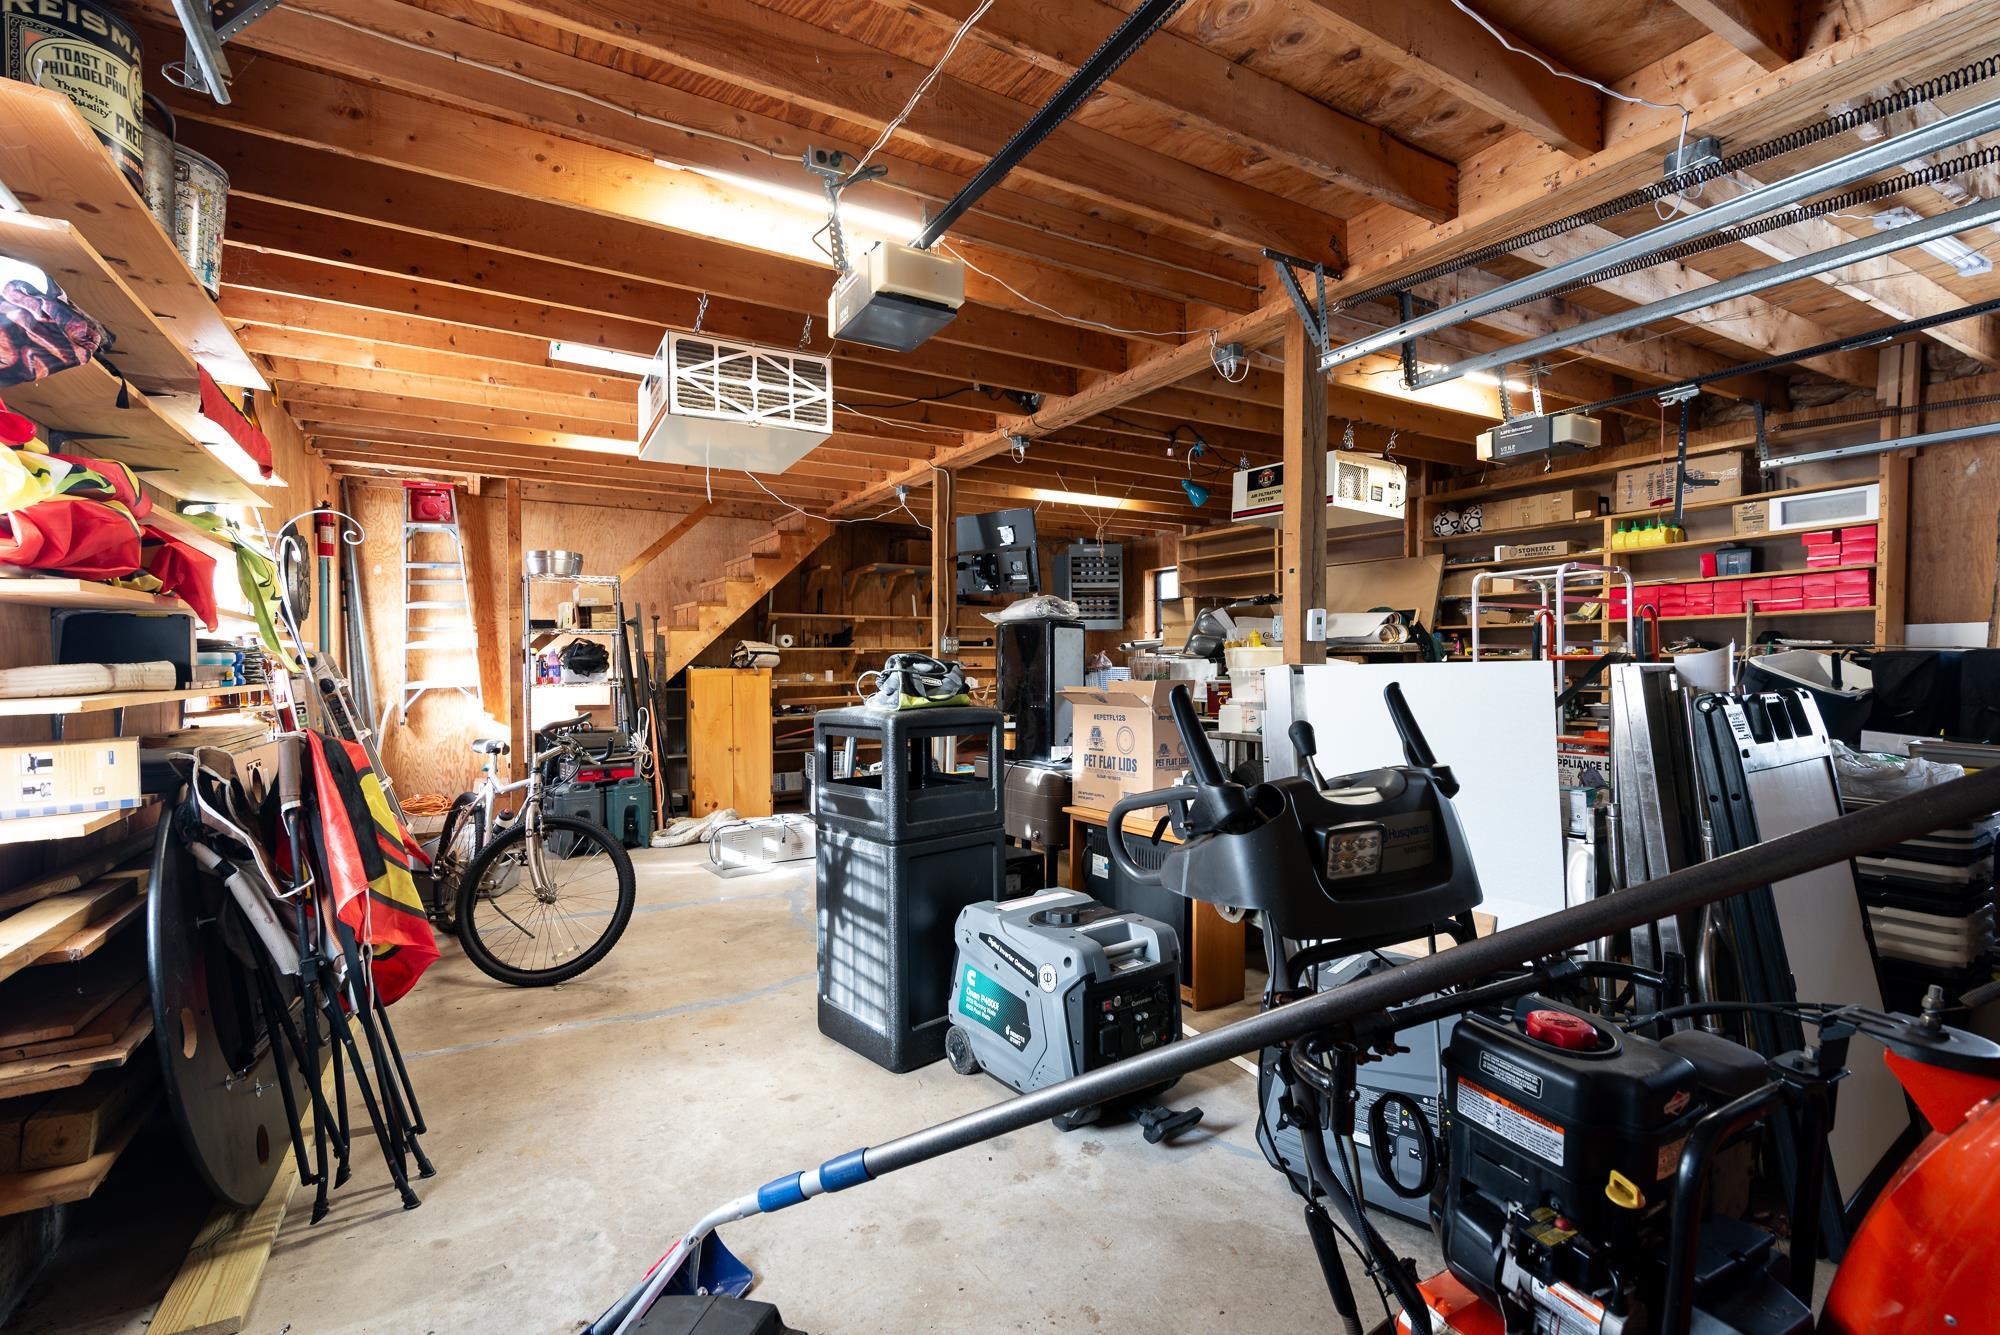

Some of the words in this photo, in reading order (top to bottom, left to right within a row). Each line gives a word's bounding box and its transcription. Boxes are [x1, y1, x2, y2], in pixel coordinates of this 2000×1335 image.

[52, 46, 100, 69] TOAST
[105, 62, 118, 78] OF
[42, 60, 128, 99] PHILADELPHIA
[1665, 467, 1674, 483] CARE
[1258, 489, 1282, 497] FILTRATION
[1518, 544, 1556, 554] STONEFACE
[1879, 541, 1887, 555] 3
[1877, 620, 1885, 633] 5
[1083, 754, 1097, 767] PET
[1098, 756, 1116, 770] FLAT
[1118, 757, 1138, 772] LIDS
[1155, 759, 1164, 767] PET
[1165, 757, 1178, 766] FLAT
[987, 936, 1000, 951] Digital
[999, 946, 1015, 963] Inverter
[1014, 958, 1036, 979] Generator
